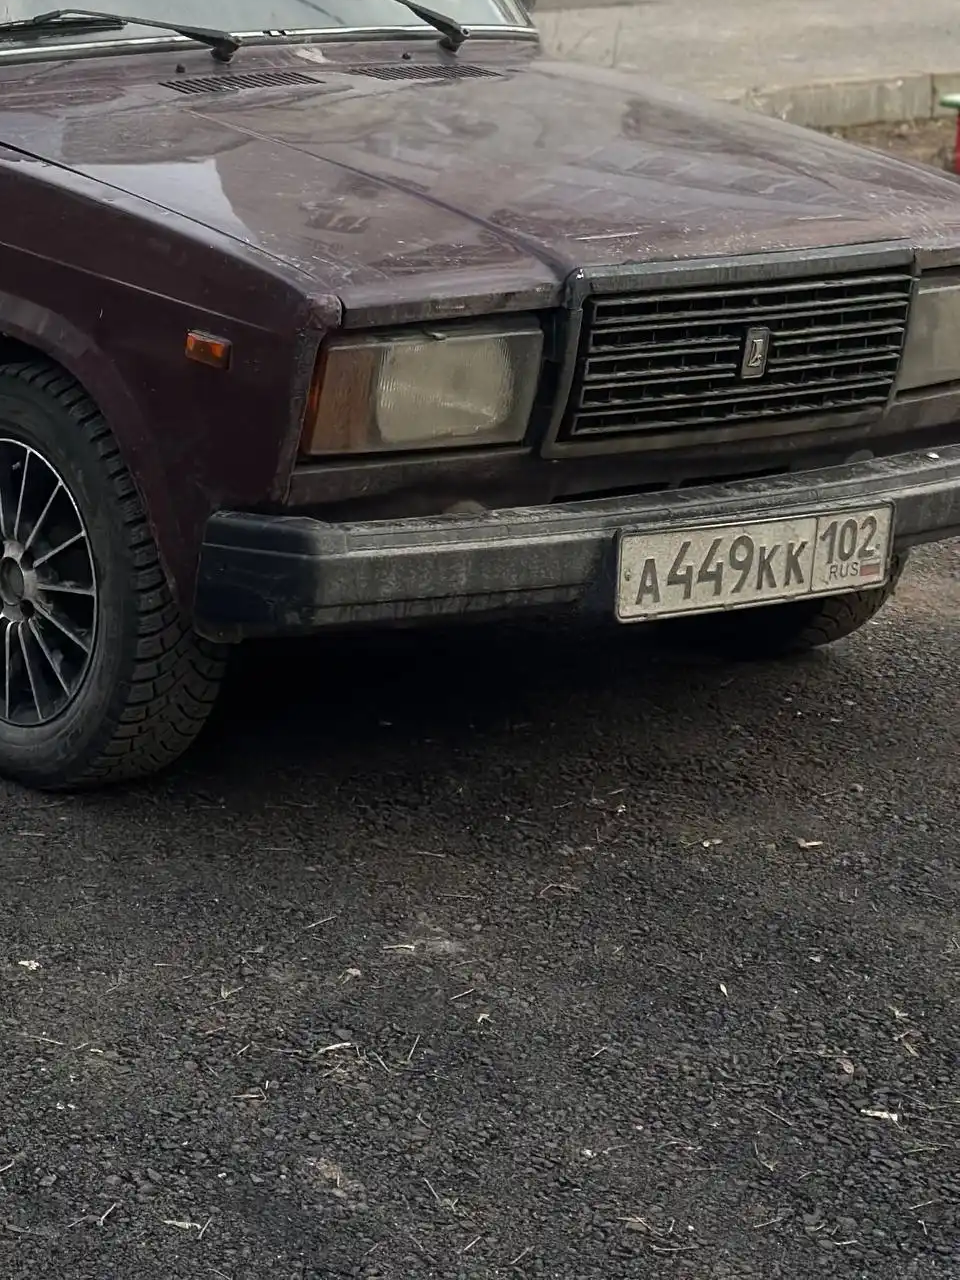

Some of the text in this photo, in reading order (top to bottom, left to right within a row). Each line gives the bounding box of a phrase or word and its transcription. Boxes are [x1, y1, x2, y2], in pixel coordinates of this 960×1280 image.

[635, 516, 877, 605] А449КК 102
[828, 561, 859, 580] RUS
